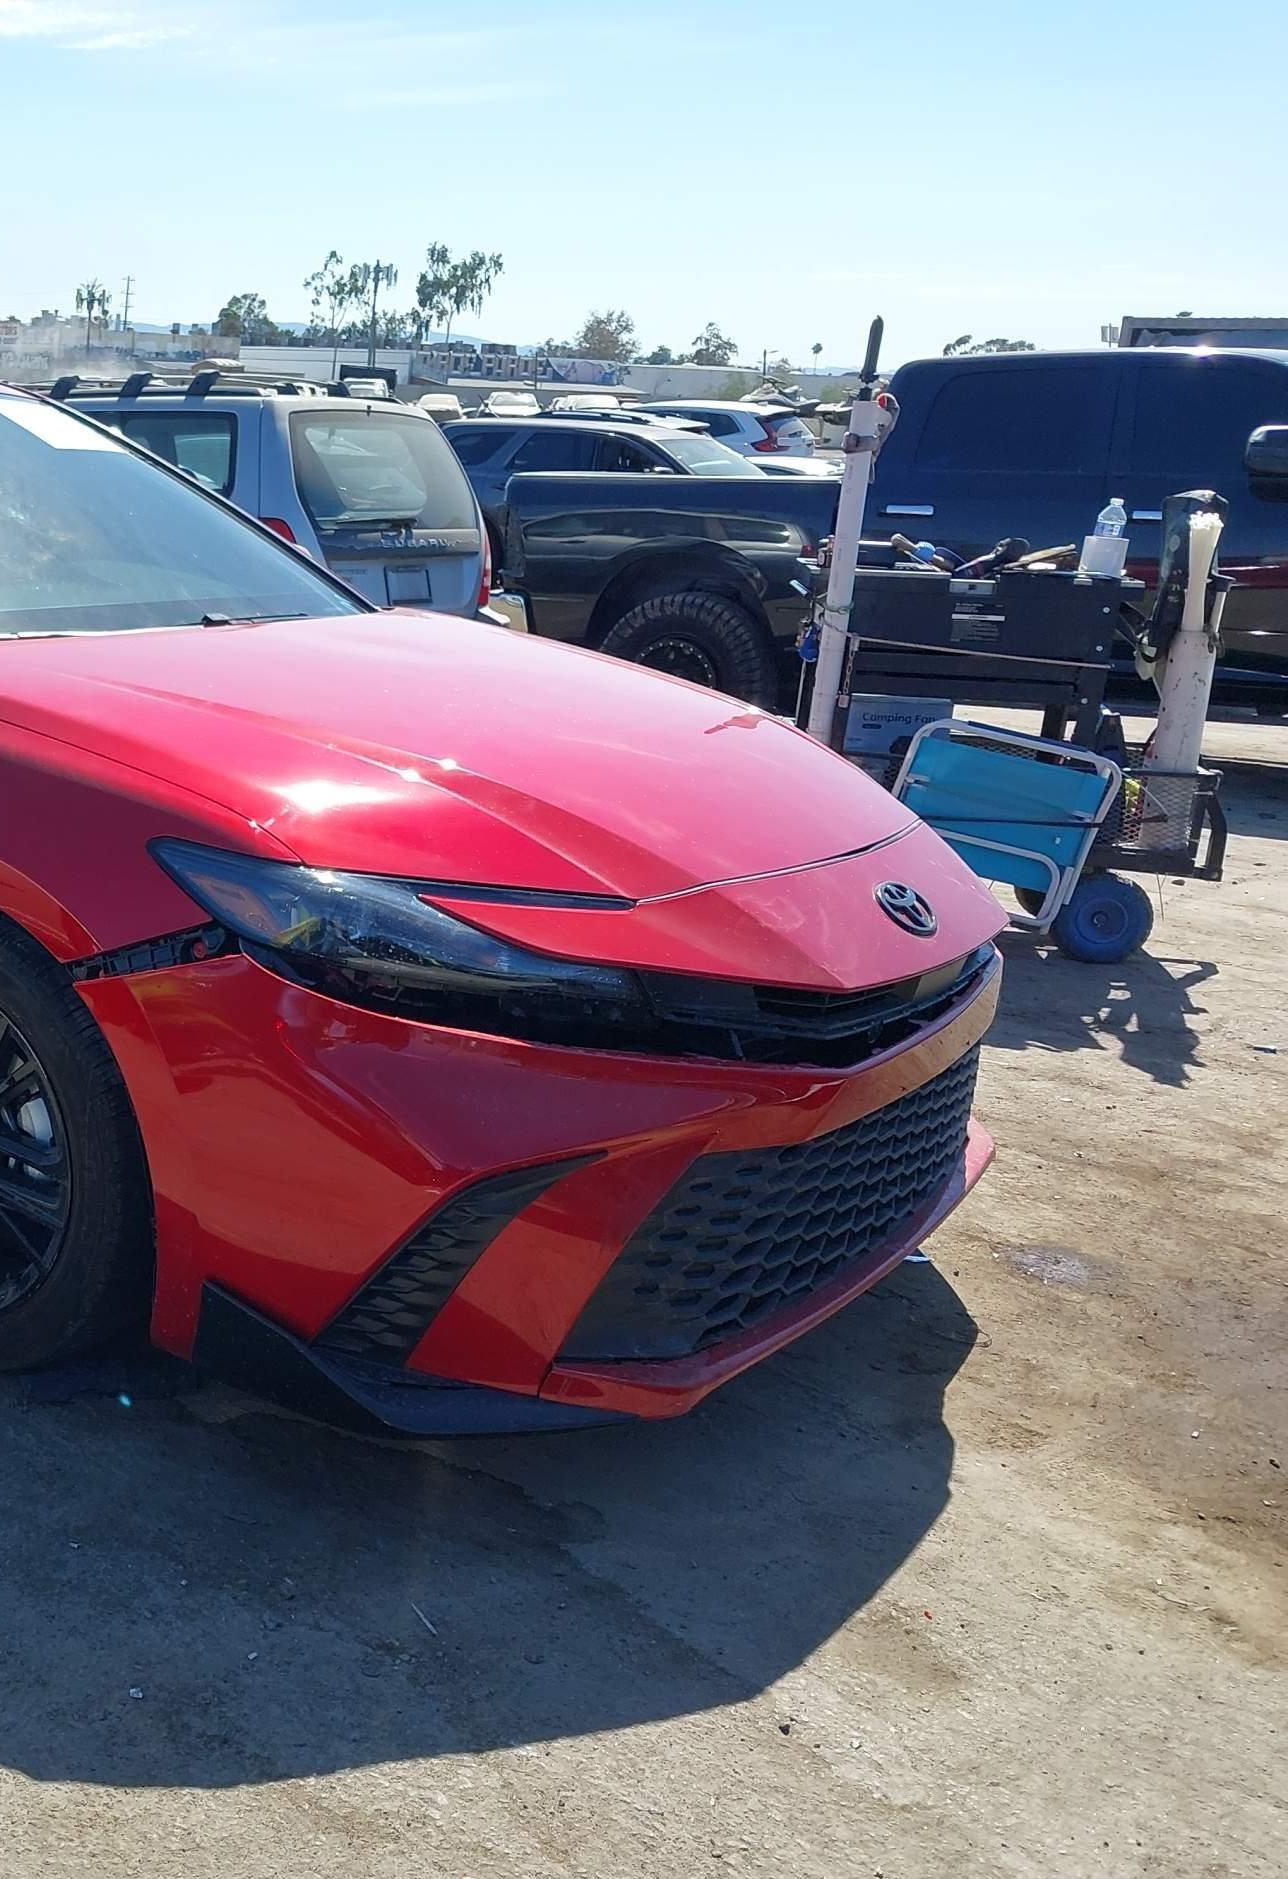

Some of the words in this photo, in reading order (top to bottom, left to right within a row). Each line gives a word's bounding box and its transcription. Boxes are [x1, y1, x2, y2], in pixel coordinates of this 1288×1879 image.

[380, 538, 451, 549] SUBARU
[862, 712, 912, 724] Camping
[915, 714, 936, 724] Fan
